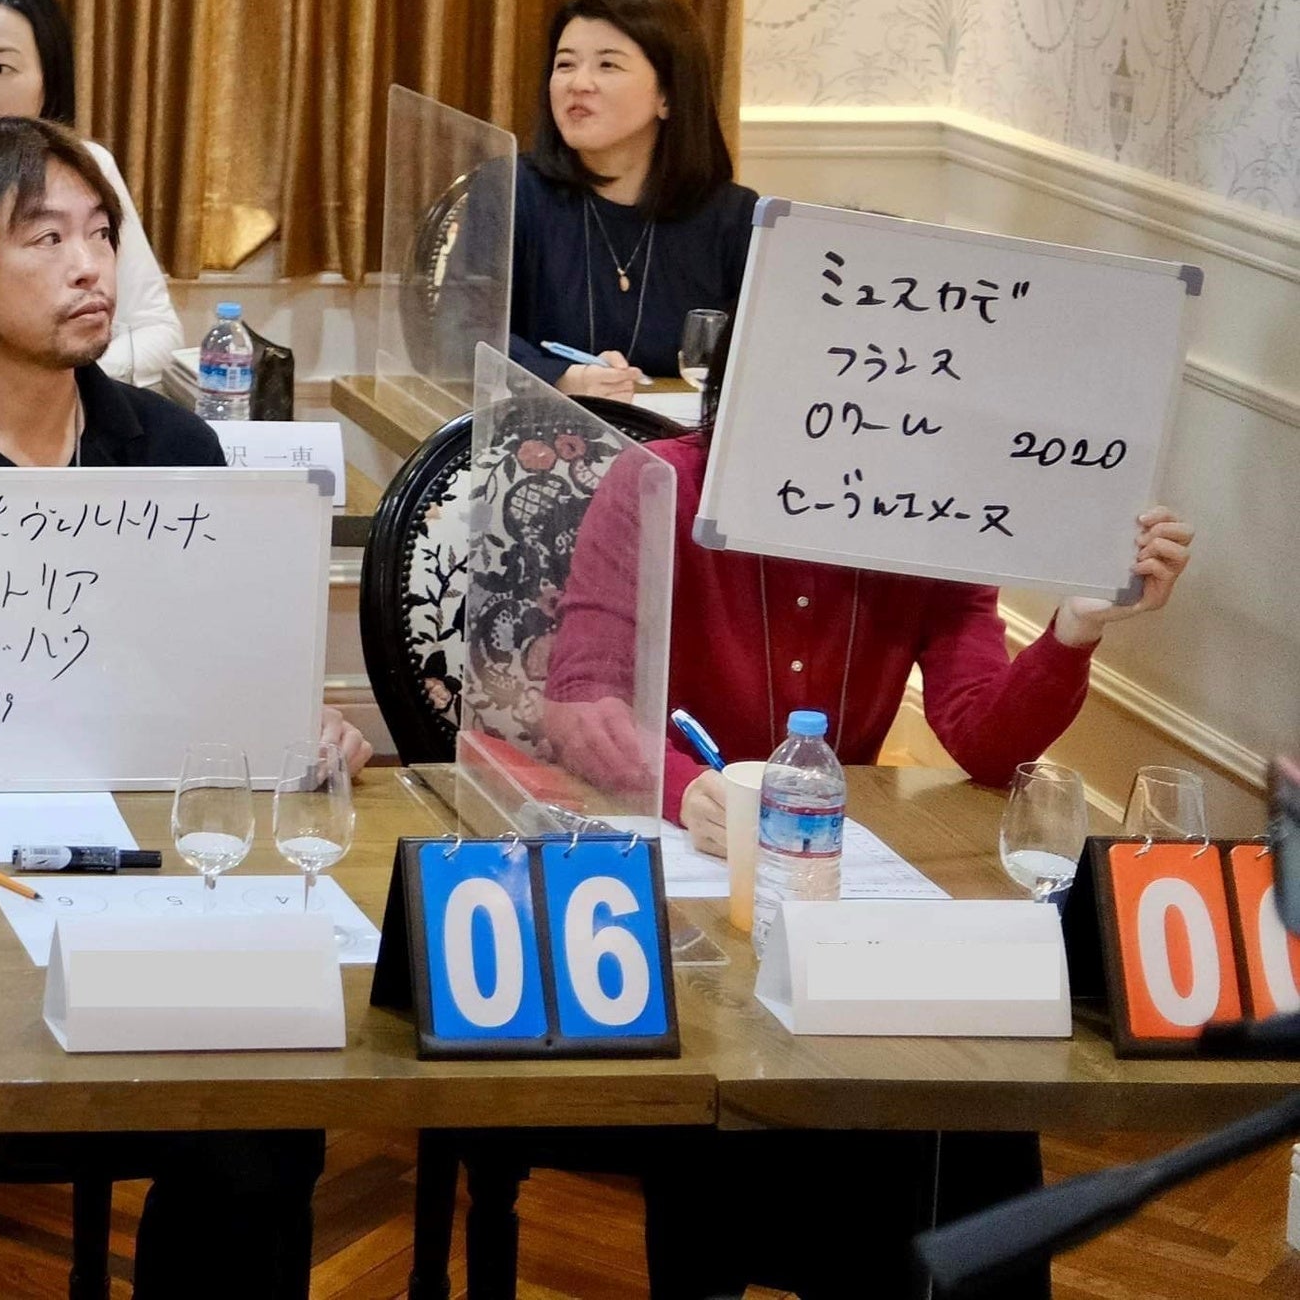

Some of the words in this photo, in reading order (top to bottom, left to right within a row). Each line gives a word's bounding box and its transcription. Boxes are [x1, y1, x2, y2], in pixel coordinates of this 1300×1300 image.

[821, 251, 1030, 324] ミュスカデ
[827, 343, 961, 382] フランス
[1010, 431, 1127, 469] 2020
[444, 874, 651, 1028] 06
